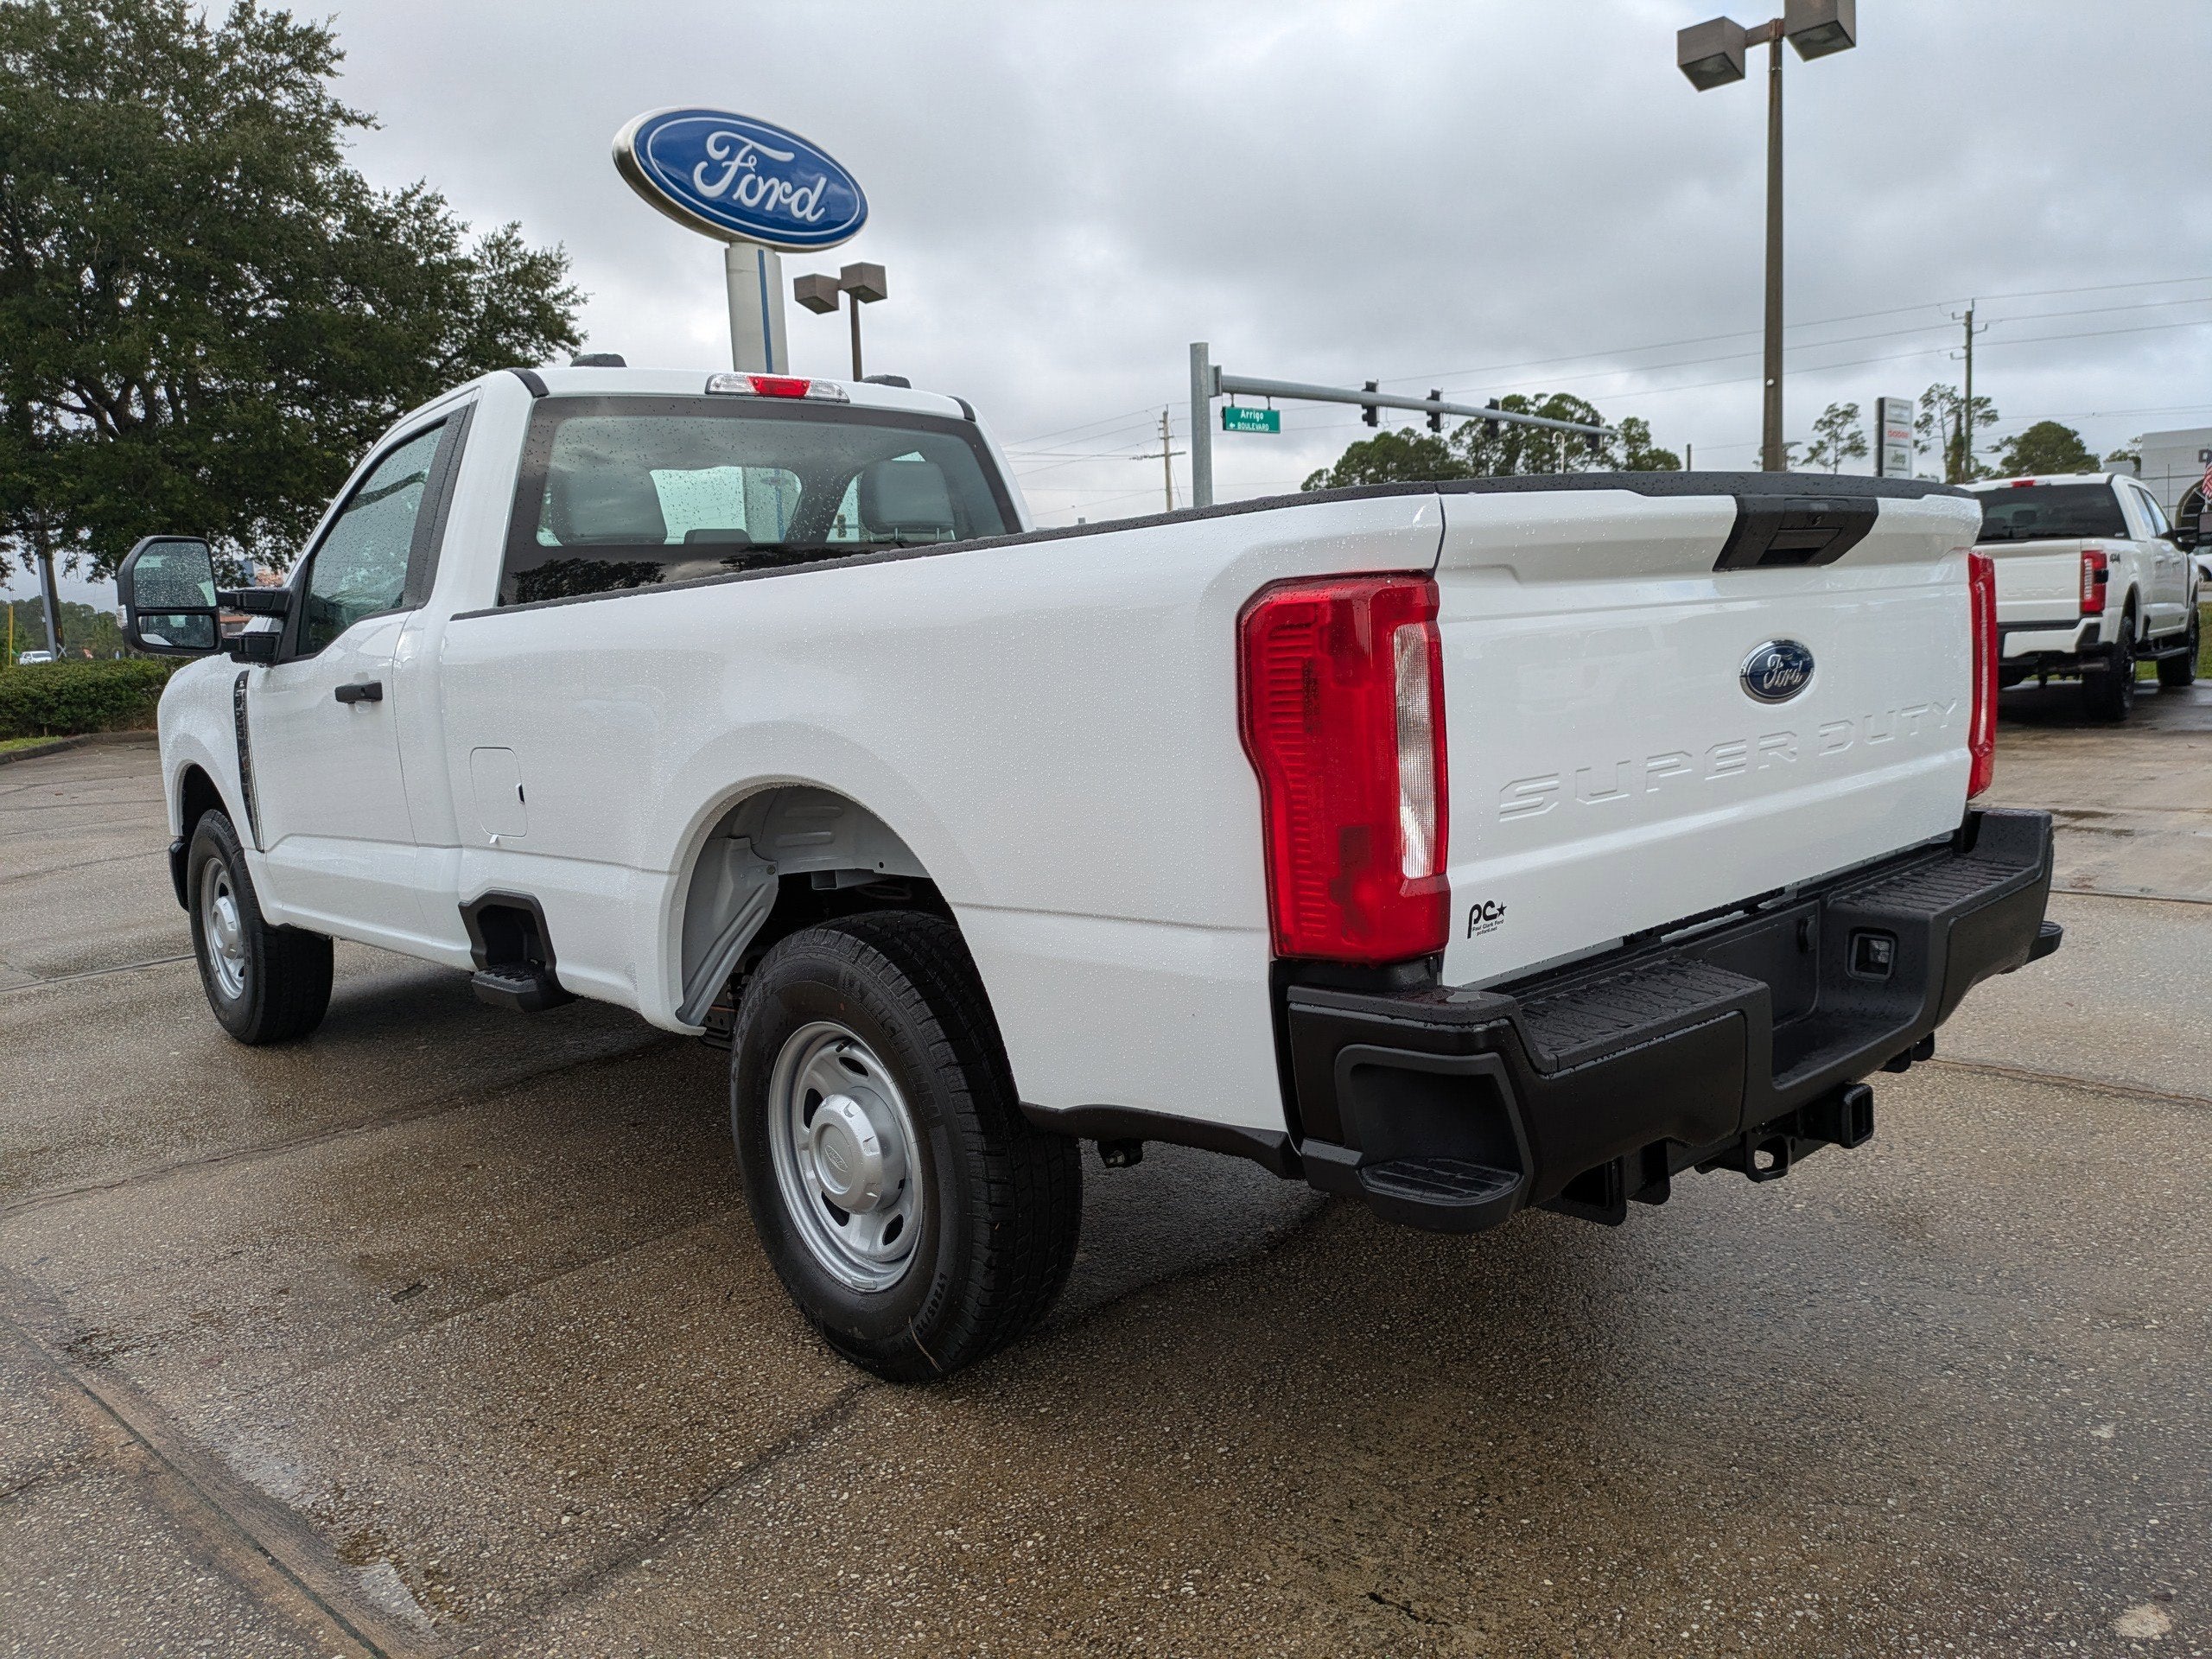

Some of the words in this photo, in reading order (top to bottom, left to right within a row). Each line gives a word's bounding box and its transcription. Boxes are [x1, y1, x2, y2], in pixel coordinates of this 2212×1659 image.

[693, 130, 827, 222] Ford
[1237, 422, 1270, 431] BOULEVARD
[1240, 409, 1264, 423] Arrigo
[1763, 653, 1803, 690] Ford
[1498, 730, 1797, 823] SUPER
[1818, 697, 1957, 756] DUTY
